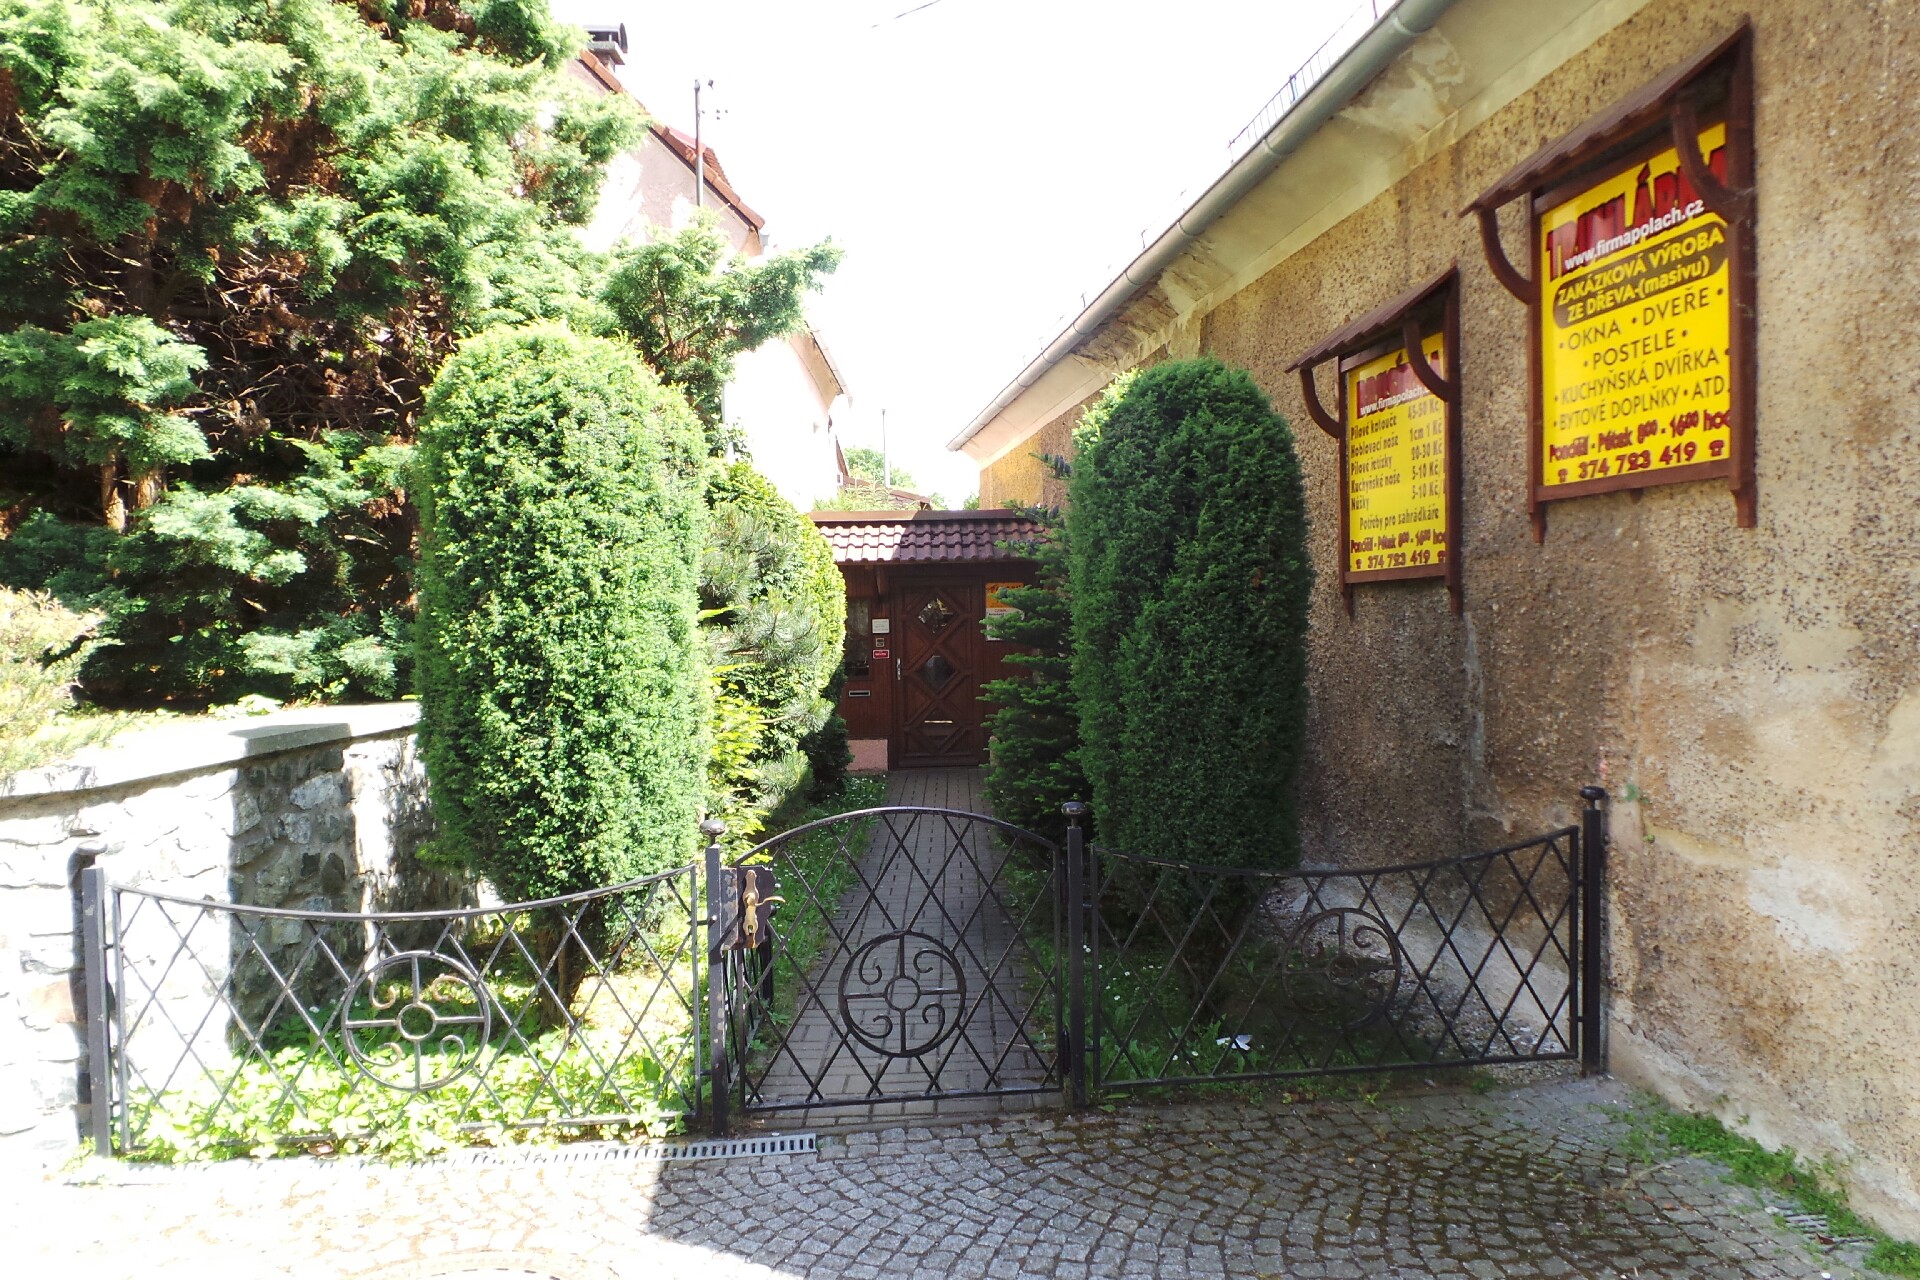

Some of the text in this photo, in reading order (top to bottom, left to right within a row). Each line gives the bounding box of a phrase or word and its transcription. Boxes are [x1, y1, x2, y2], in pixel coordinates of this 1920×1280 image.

[1564, 199, 1705, 270] www.firmapolach.cz
[1558, 227, 1726, 305] ZAKÁZKOVÁ VÝROBA
[1567, 302, 1585, 323] ZE
[1567, 285, 1710, 351] OKNA DVEŘE
[1593, 329, 1676, 370] POSTELE
[1561, 347, 1719, 406] KUCHYŇSKÁ DVÍŘKA
[1371, 412, 1397, 435] kotouče
[1559, 403, 1606, 431] BYTOVÉ
[1611, 385, 1681, 420] DOPLŇKY
[1578, 458, 1610, 479] 374
[1659, 441, 1697, 465] 419
[1350, 474, 1384, 494] Kuchyňské
[1385, 469, 1401, 485] nože
[1350, 495, 1370, 511] Nůžky
[1385, 514, 1396, 530] pro
[1398, 504, 1439, 525] zahrádkáře
[1368, 555, 1384, 569] 374
[1410, 550, 1431, 565] 419
